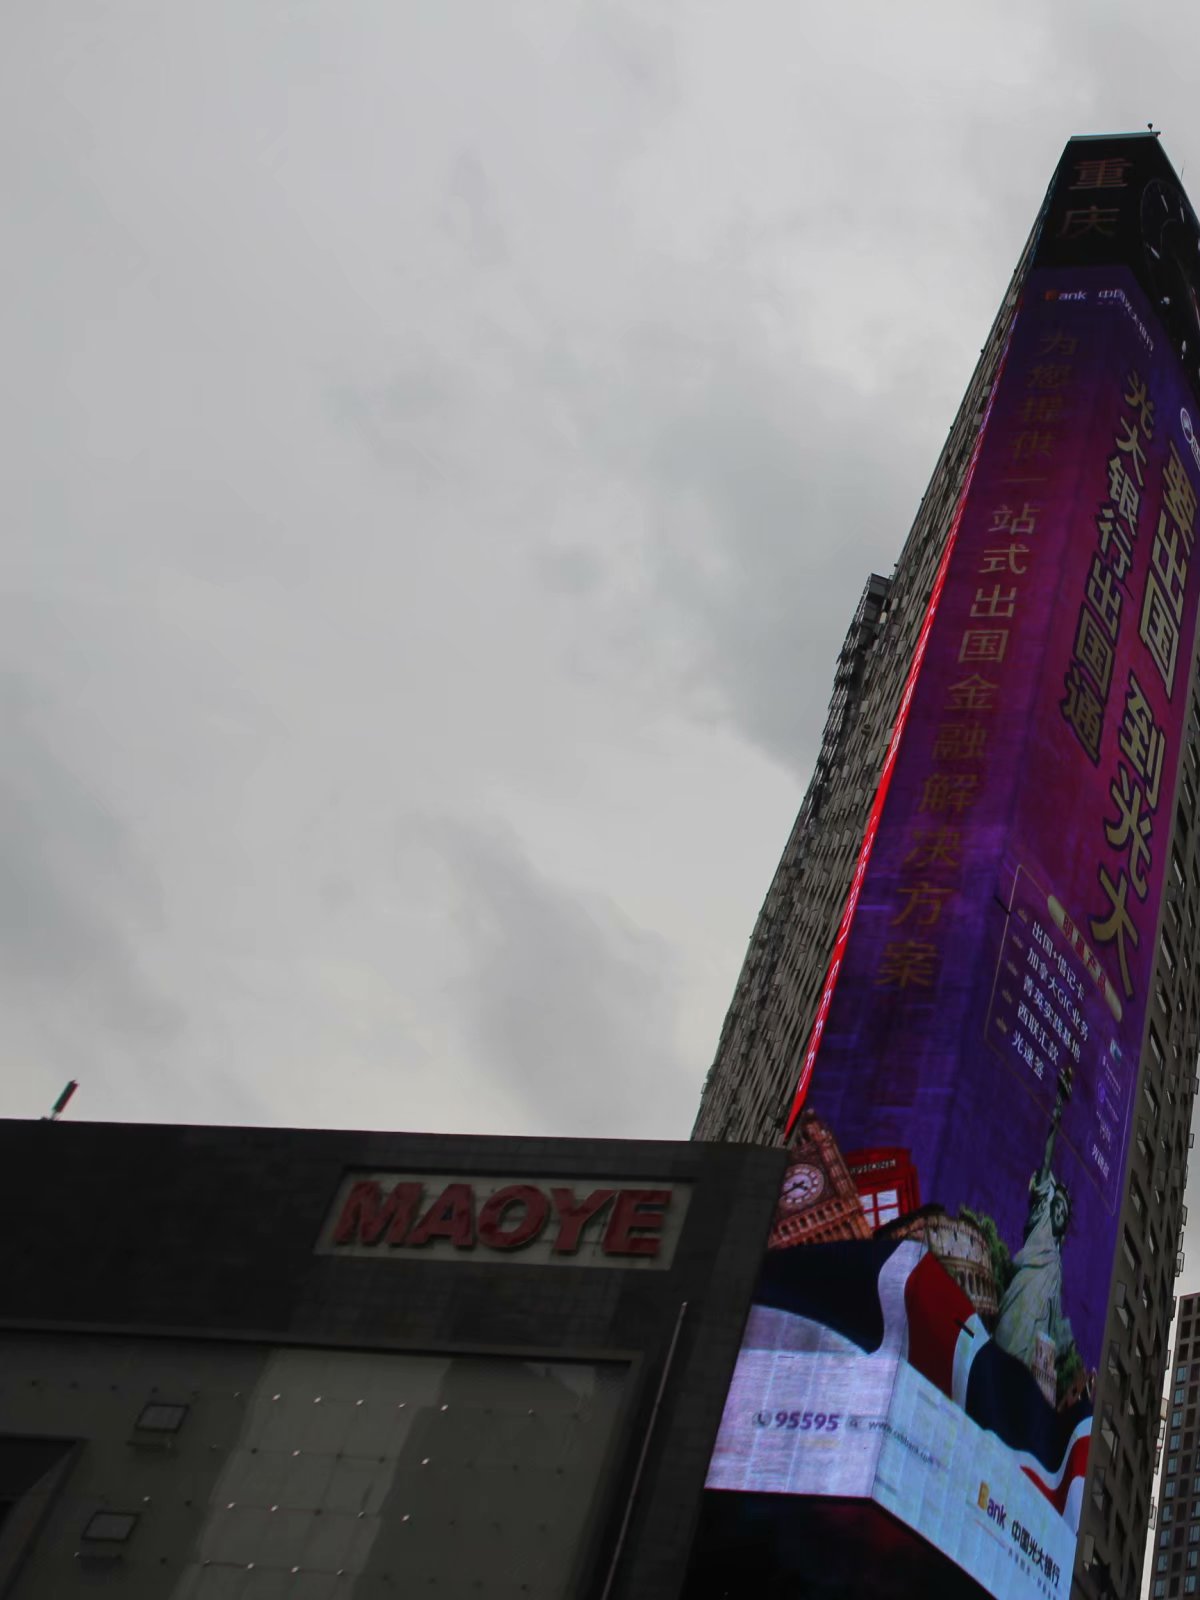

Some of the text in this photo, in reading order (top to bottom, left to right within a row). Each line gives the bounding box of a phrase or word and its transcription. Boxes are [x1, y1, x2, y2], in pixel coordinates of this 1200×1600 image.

[1056, 157, 1133, 239] 重庆
[1061, 370, 1153, 765] 光大银行出国通
[333, 1180, 673, 1257] MAOYE
[775, 1412, 839, 1431] 95595
[1011, 1520, 1060, 1588] 中国光大银行
